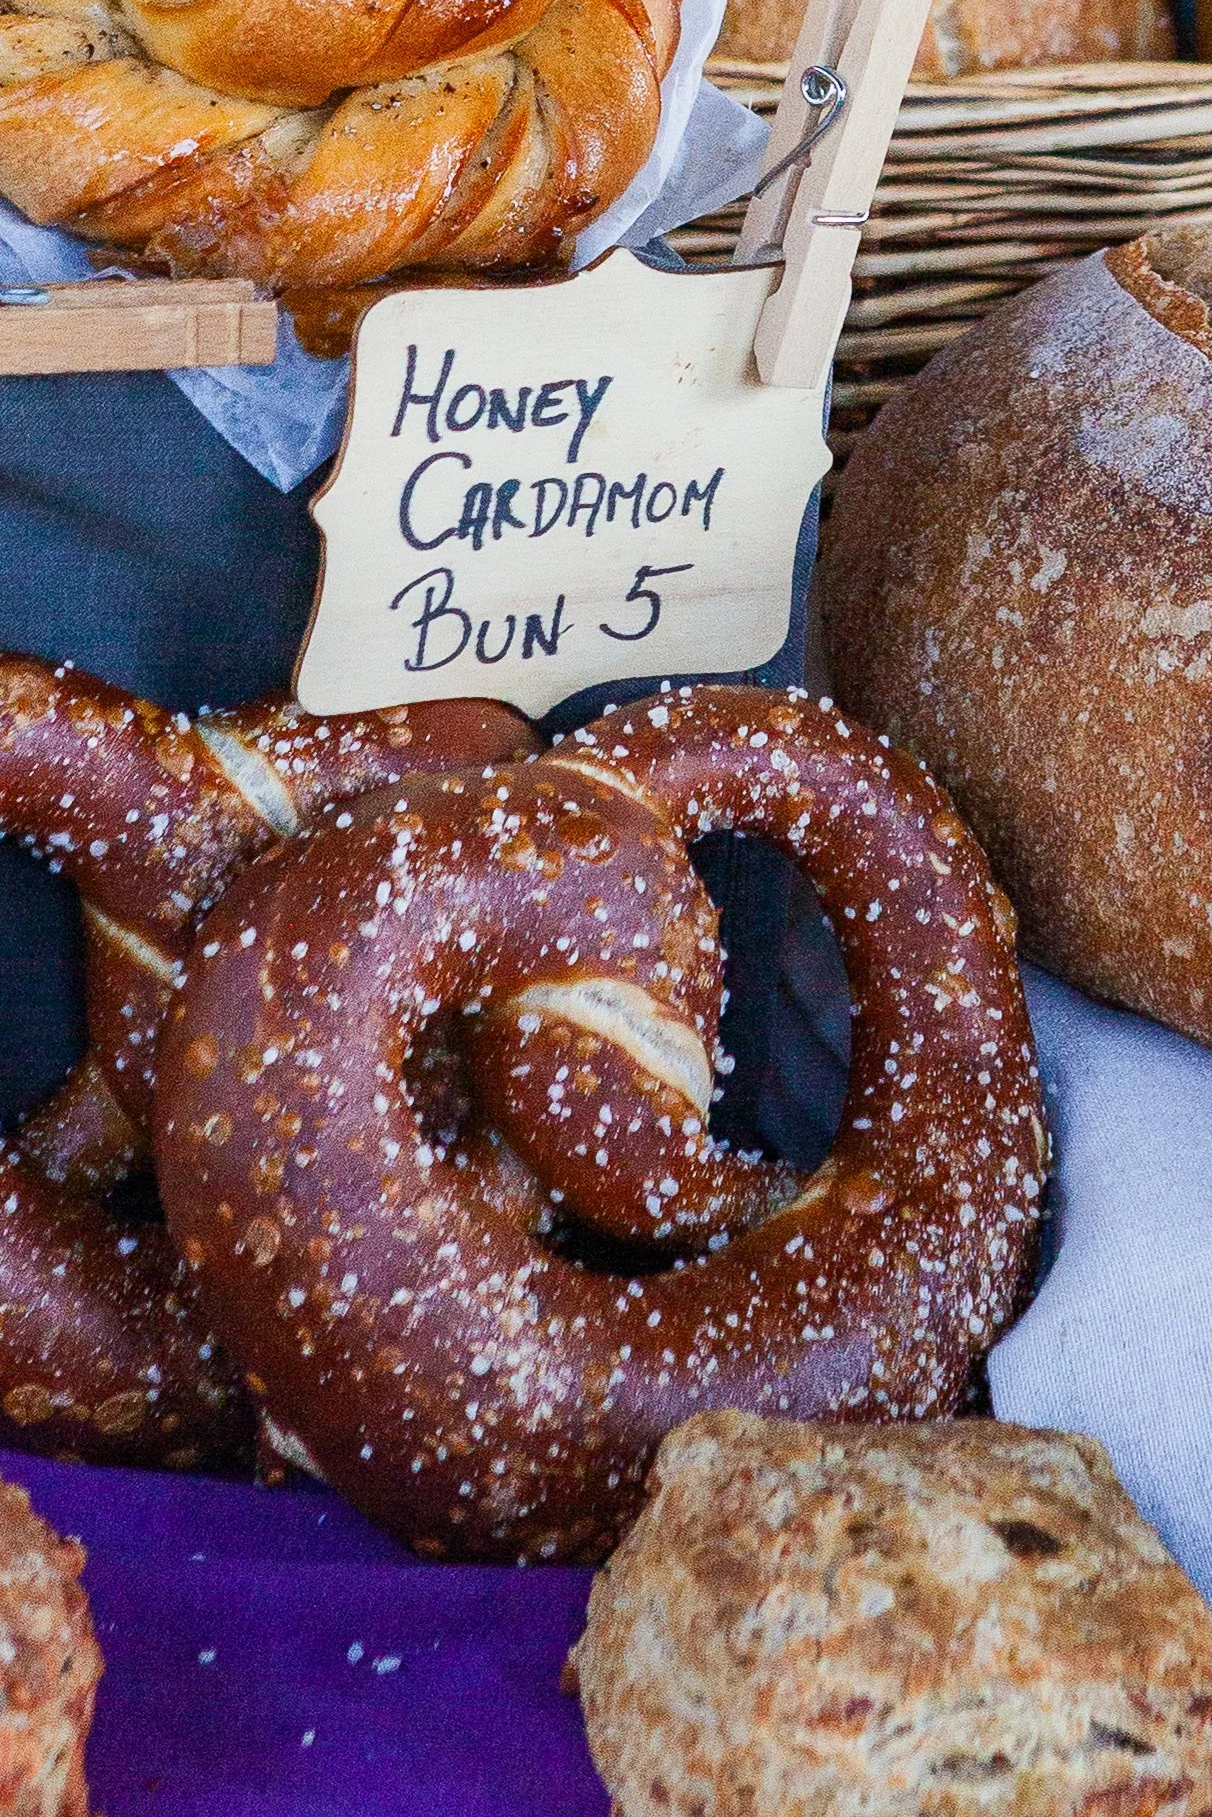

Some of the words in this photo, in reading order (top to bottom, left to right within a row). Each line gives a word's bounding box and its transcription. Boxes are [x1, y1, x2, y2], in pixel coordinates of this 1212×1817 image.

[389, 343, 615, 464] HONEY
[398, 451, 727, 551] CARDAMOM
[388, 566, 575, 673] BUN
[598, 562, 696, 642] 5
